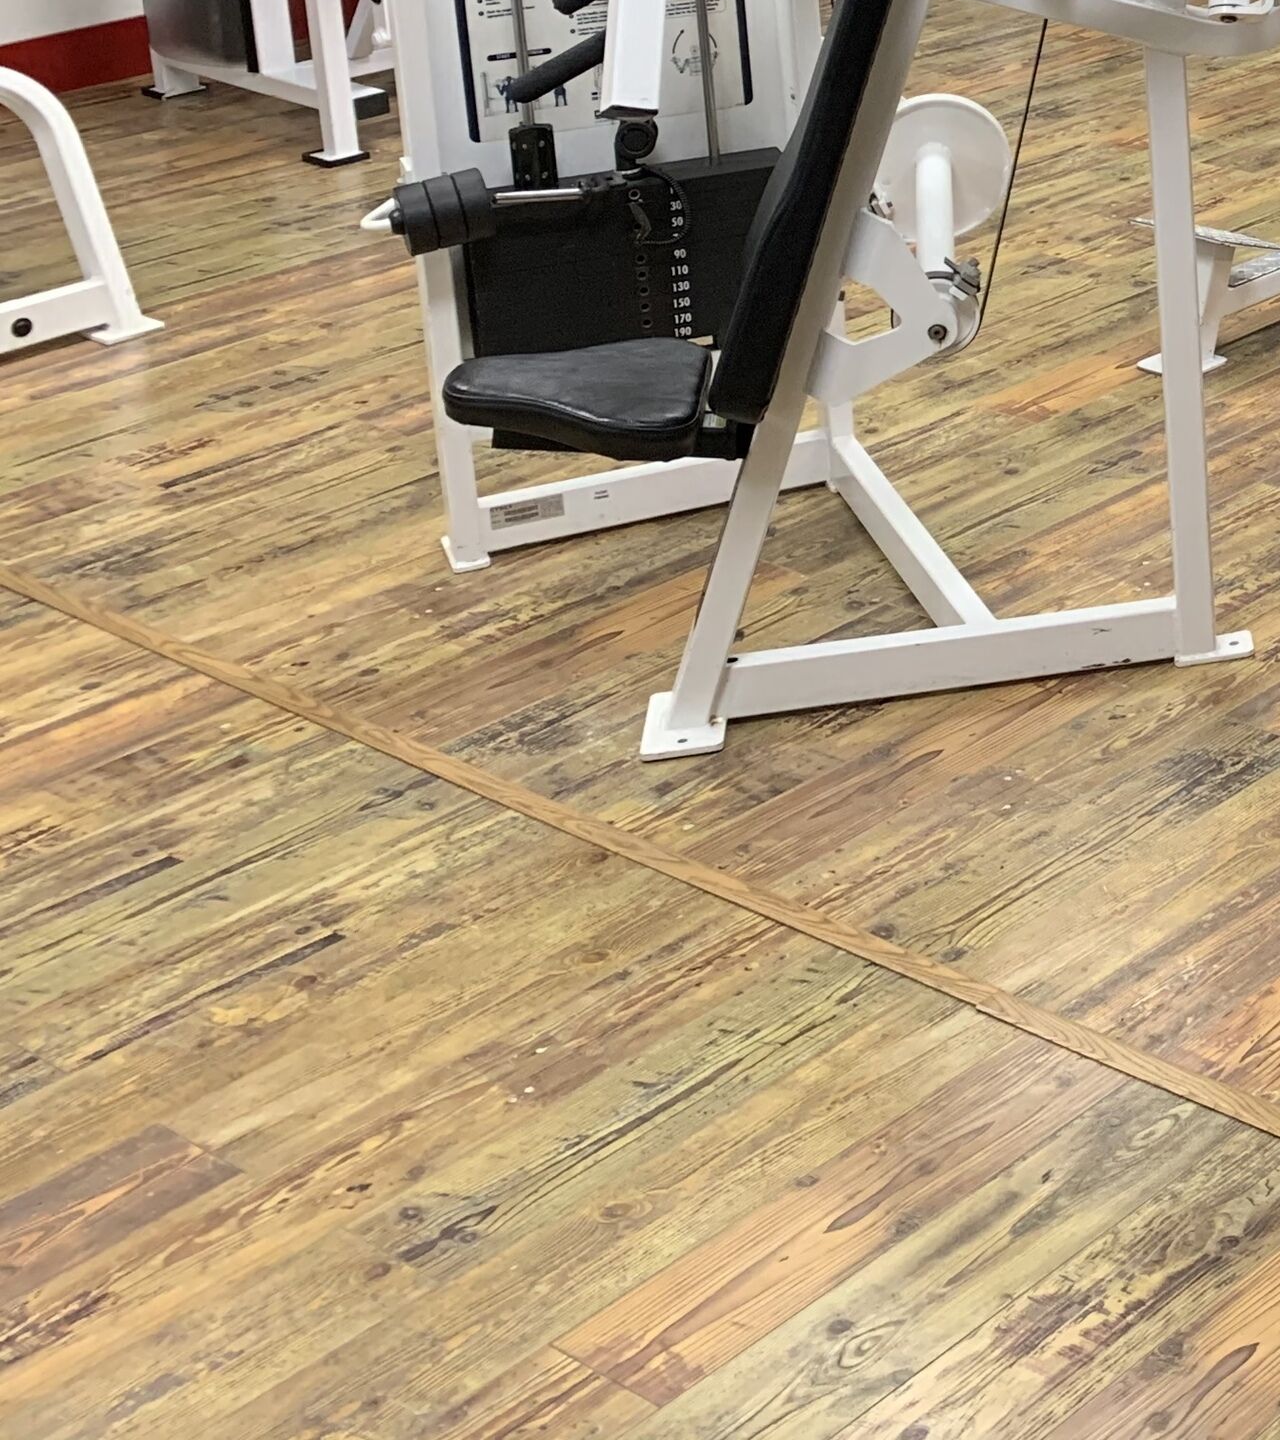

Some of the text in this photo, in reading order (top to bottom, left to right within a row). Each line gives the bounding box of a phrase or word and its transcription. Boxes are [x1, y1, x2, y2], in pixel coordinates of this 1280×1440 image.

[670, 200, 682, 211] 30
[671, 216, 684, 228] 50
[673, 248, 687, 259] 90
[671, 264, 689, 276] 110
[672, 280, 690, 292] 130
[673, 296, 691, 308] 150
[674, 312, 692, 324] 170
[674, 326, 692, 338] 190
